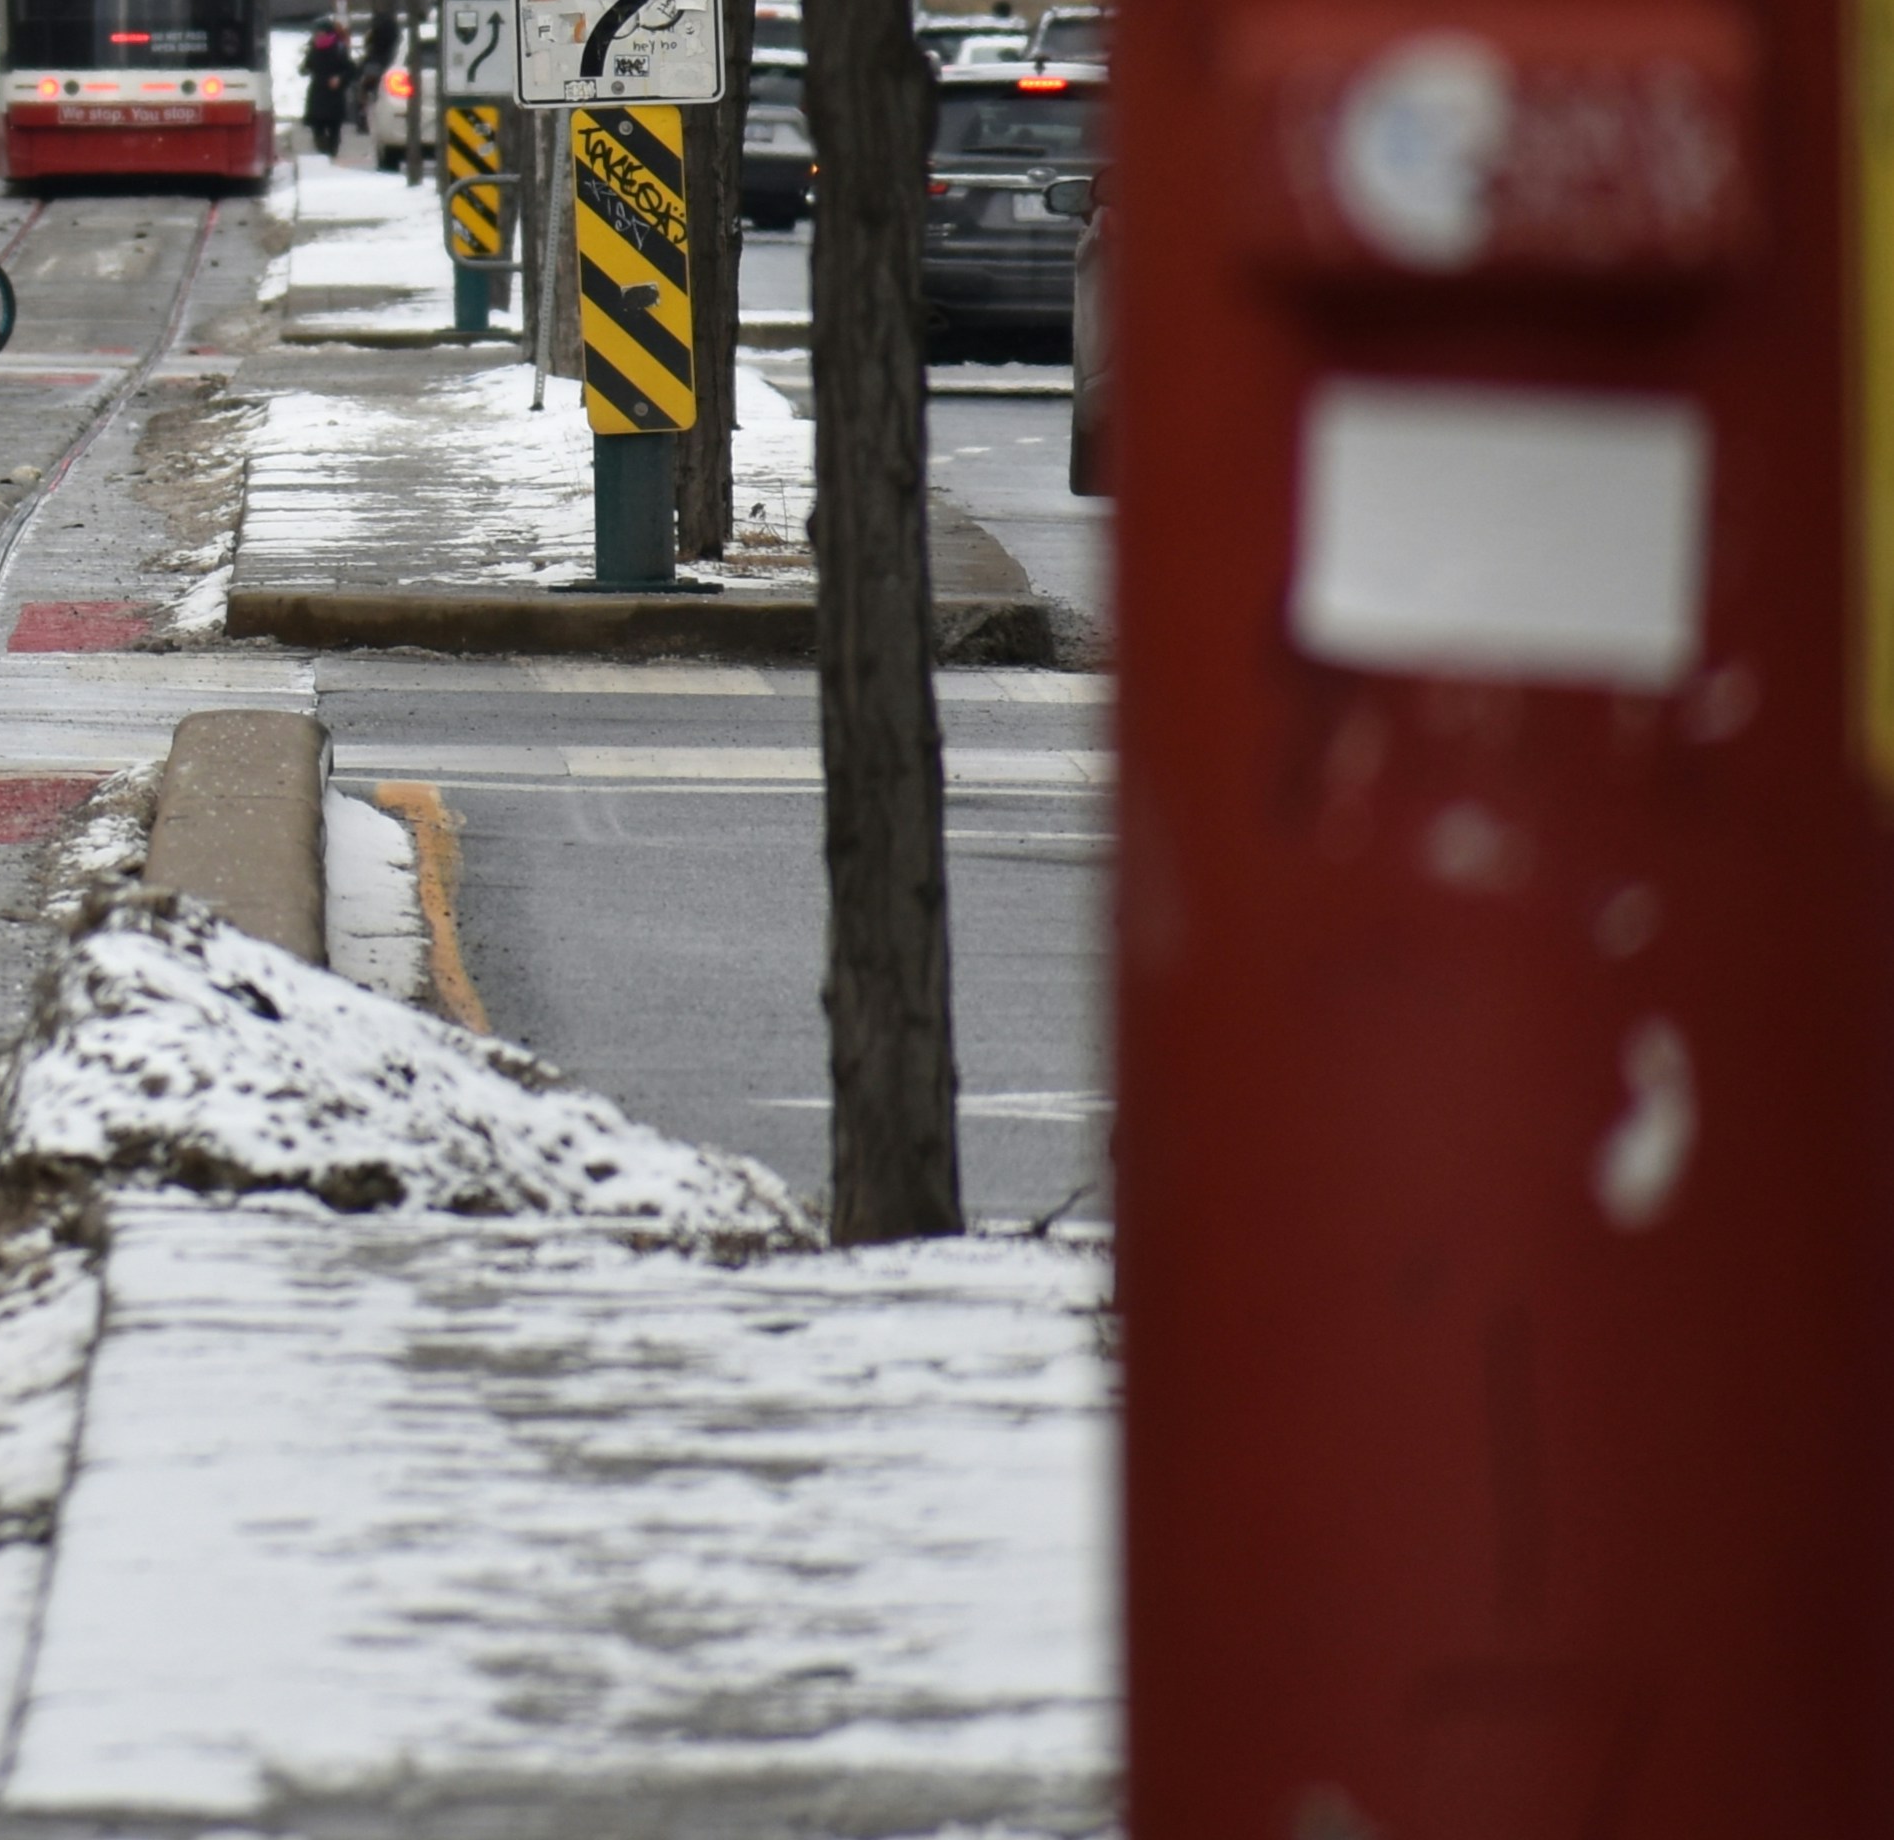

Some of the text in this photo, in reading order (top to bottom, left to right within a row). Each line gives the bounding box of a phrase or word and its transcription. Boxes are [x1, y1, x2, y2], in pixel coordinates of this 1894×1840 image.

[63, 108, 85, 121] We
[88, 108, 126, 124] stop.
[131, 107, 159, 122] You
